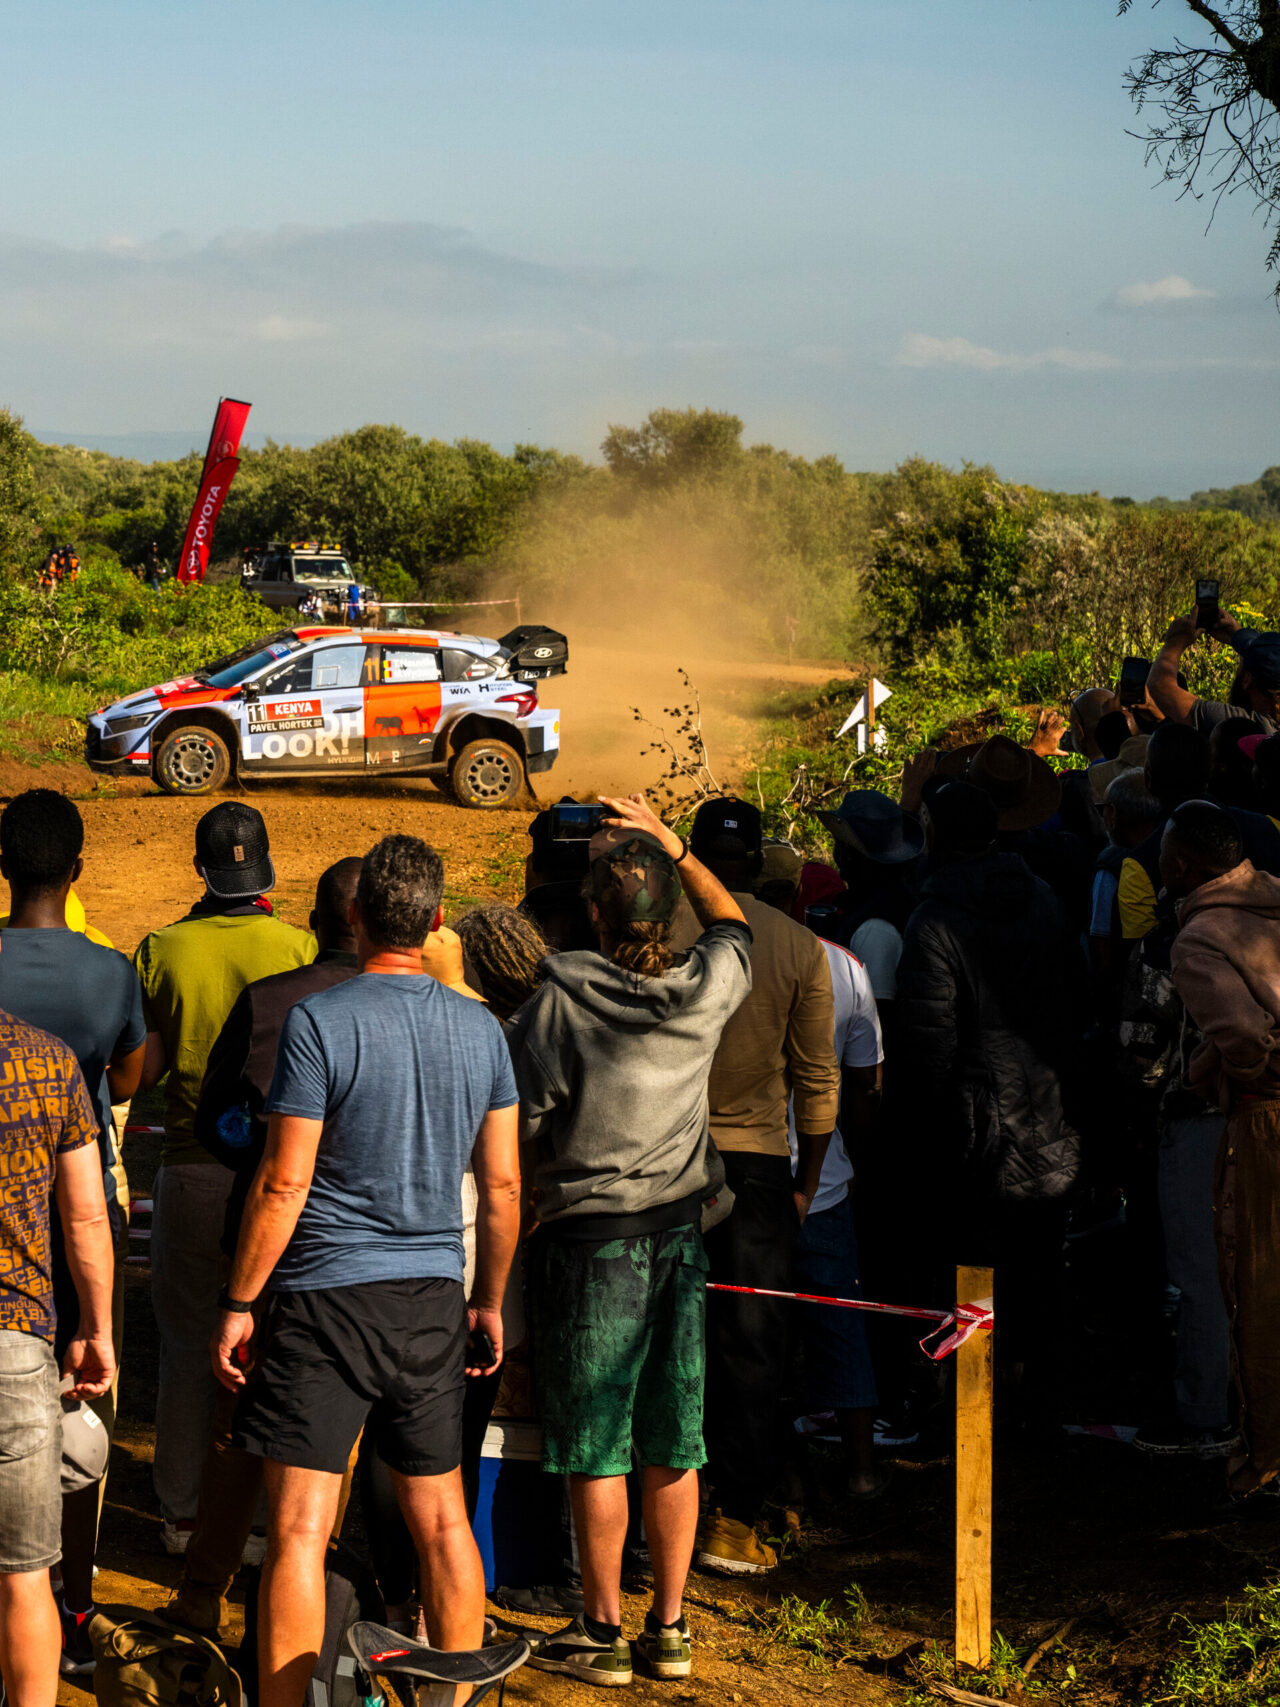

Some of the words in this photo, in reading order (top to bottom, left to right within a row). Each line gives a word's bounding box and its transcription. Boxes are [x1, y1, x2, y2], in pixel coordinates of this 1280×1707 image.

[193, 484, 222, 547] TOYOTA
[364, 657, 380, 682] 11
[249, 705, 265, 722] 11
[275, 702, 313, 715] KENYA
[250, 722, 277, 733] PAVEL
[243, 733, 350, 760] LOOK!
[660, 1649, 682, 1657] PUMA
